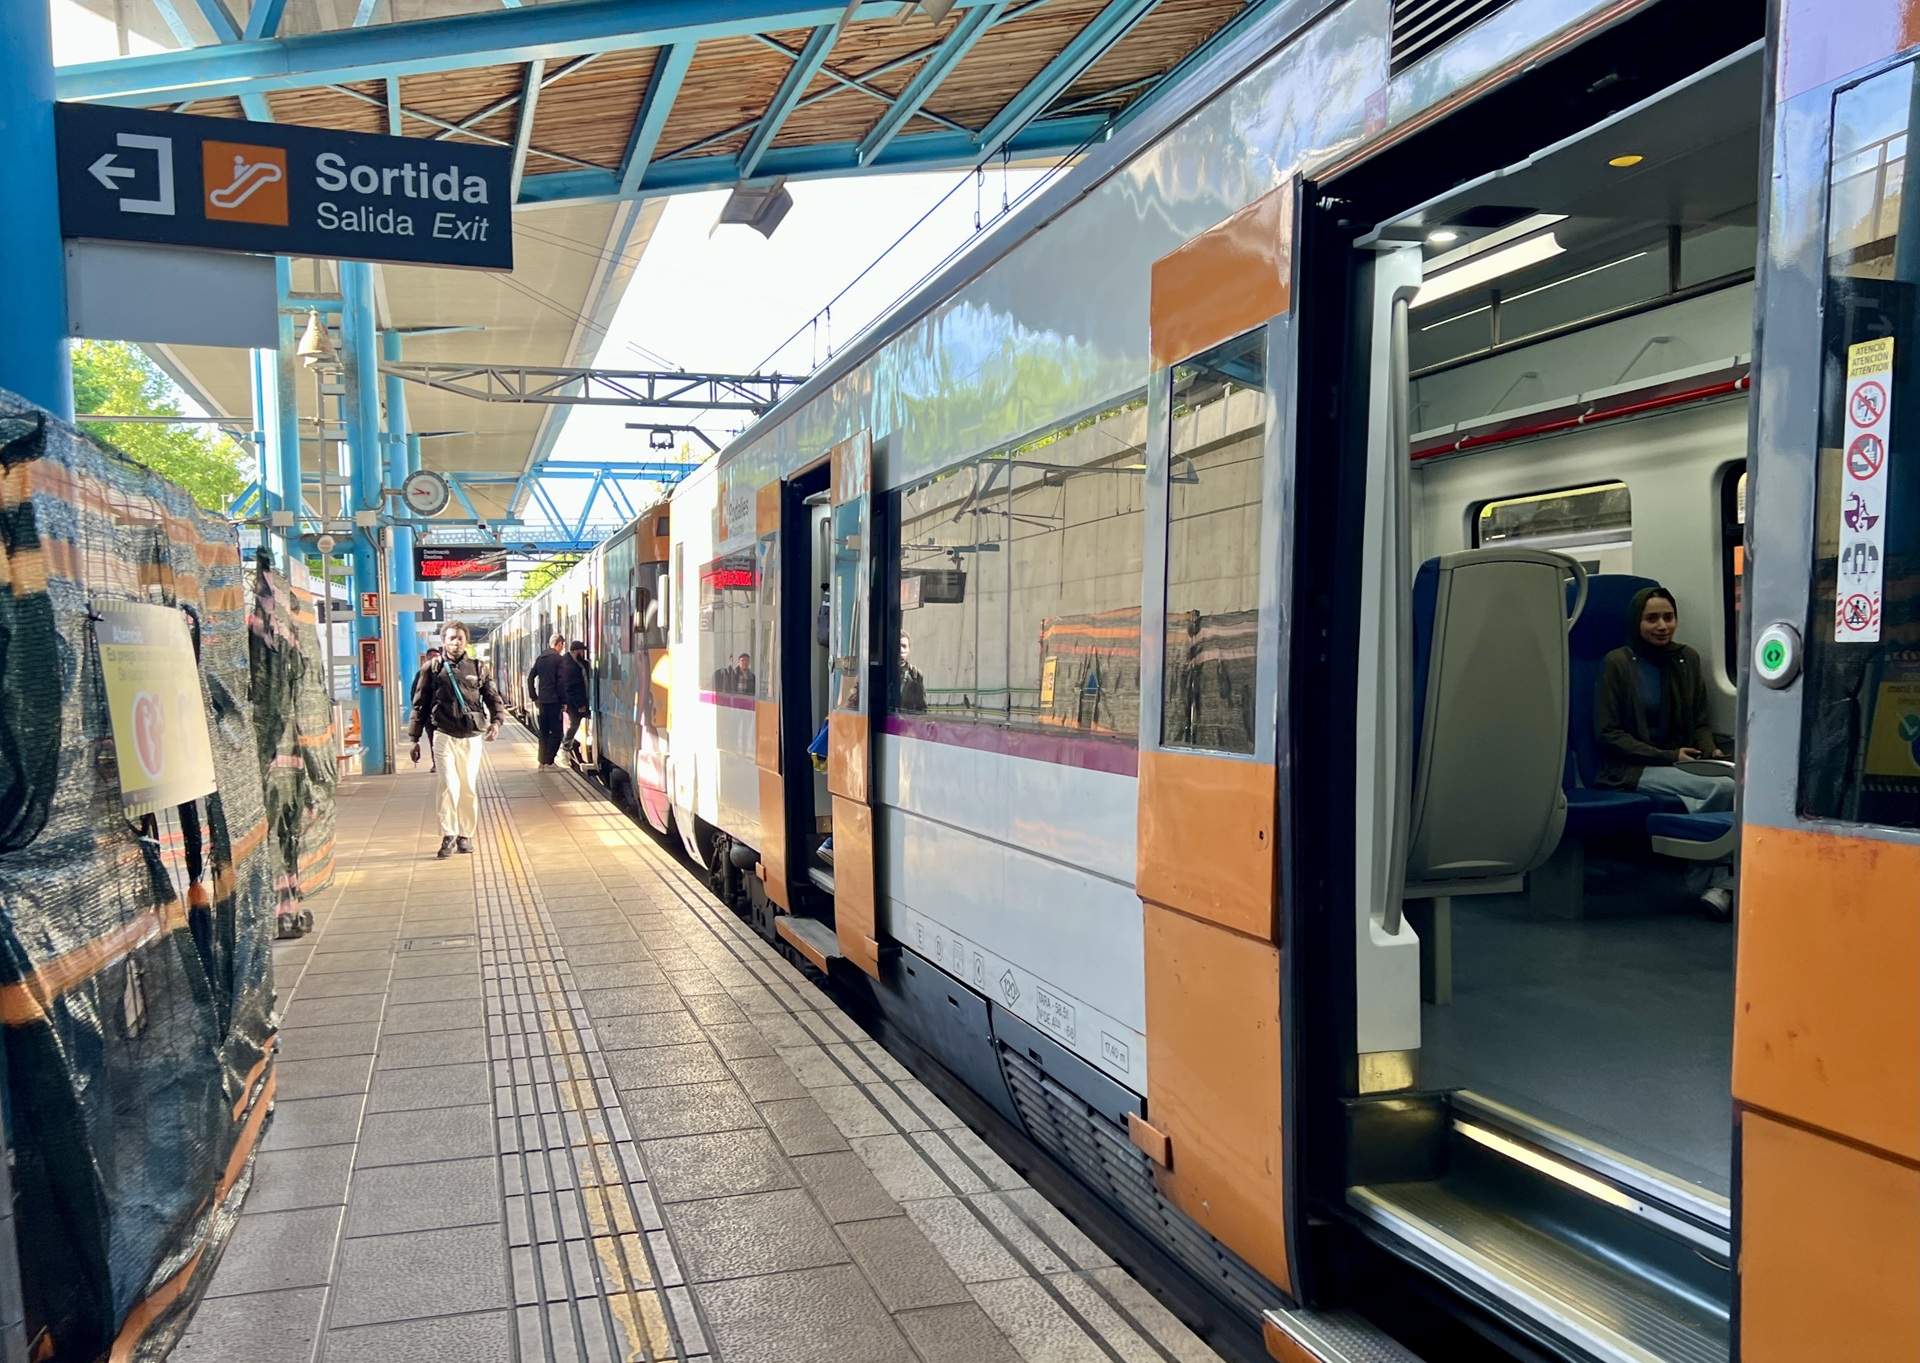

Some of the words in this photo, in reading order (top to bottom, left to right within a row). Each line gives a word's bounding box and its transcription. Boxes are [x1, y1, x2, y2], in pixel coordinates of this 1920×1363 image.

[315, 152, 489, 204] Sortida
[316, 202, 414, 237] Salida
[432, 211, 489, 242] Exit
[1850, 362, 1889, 376] ATTENTION
[428, 607, 437, 620] 1
